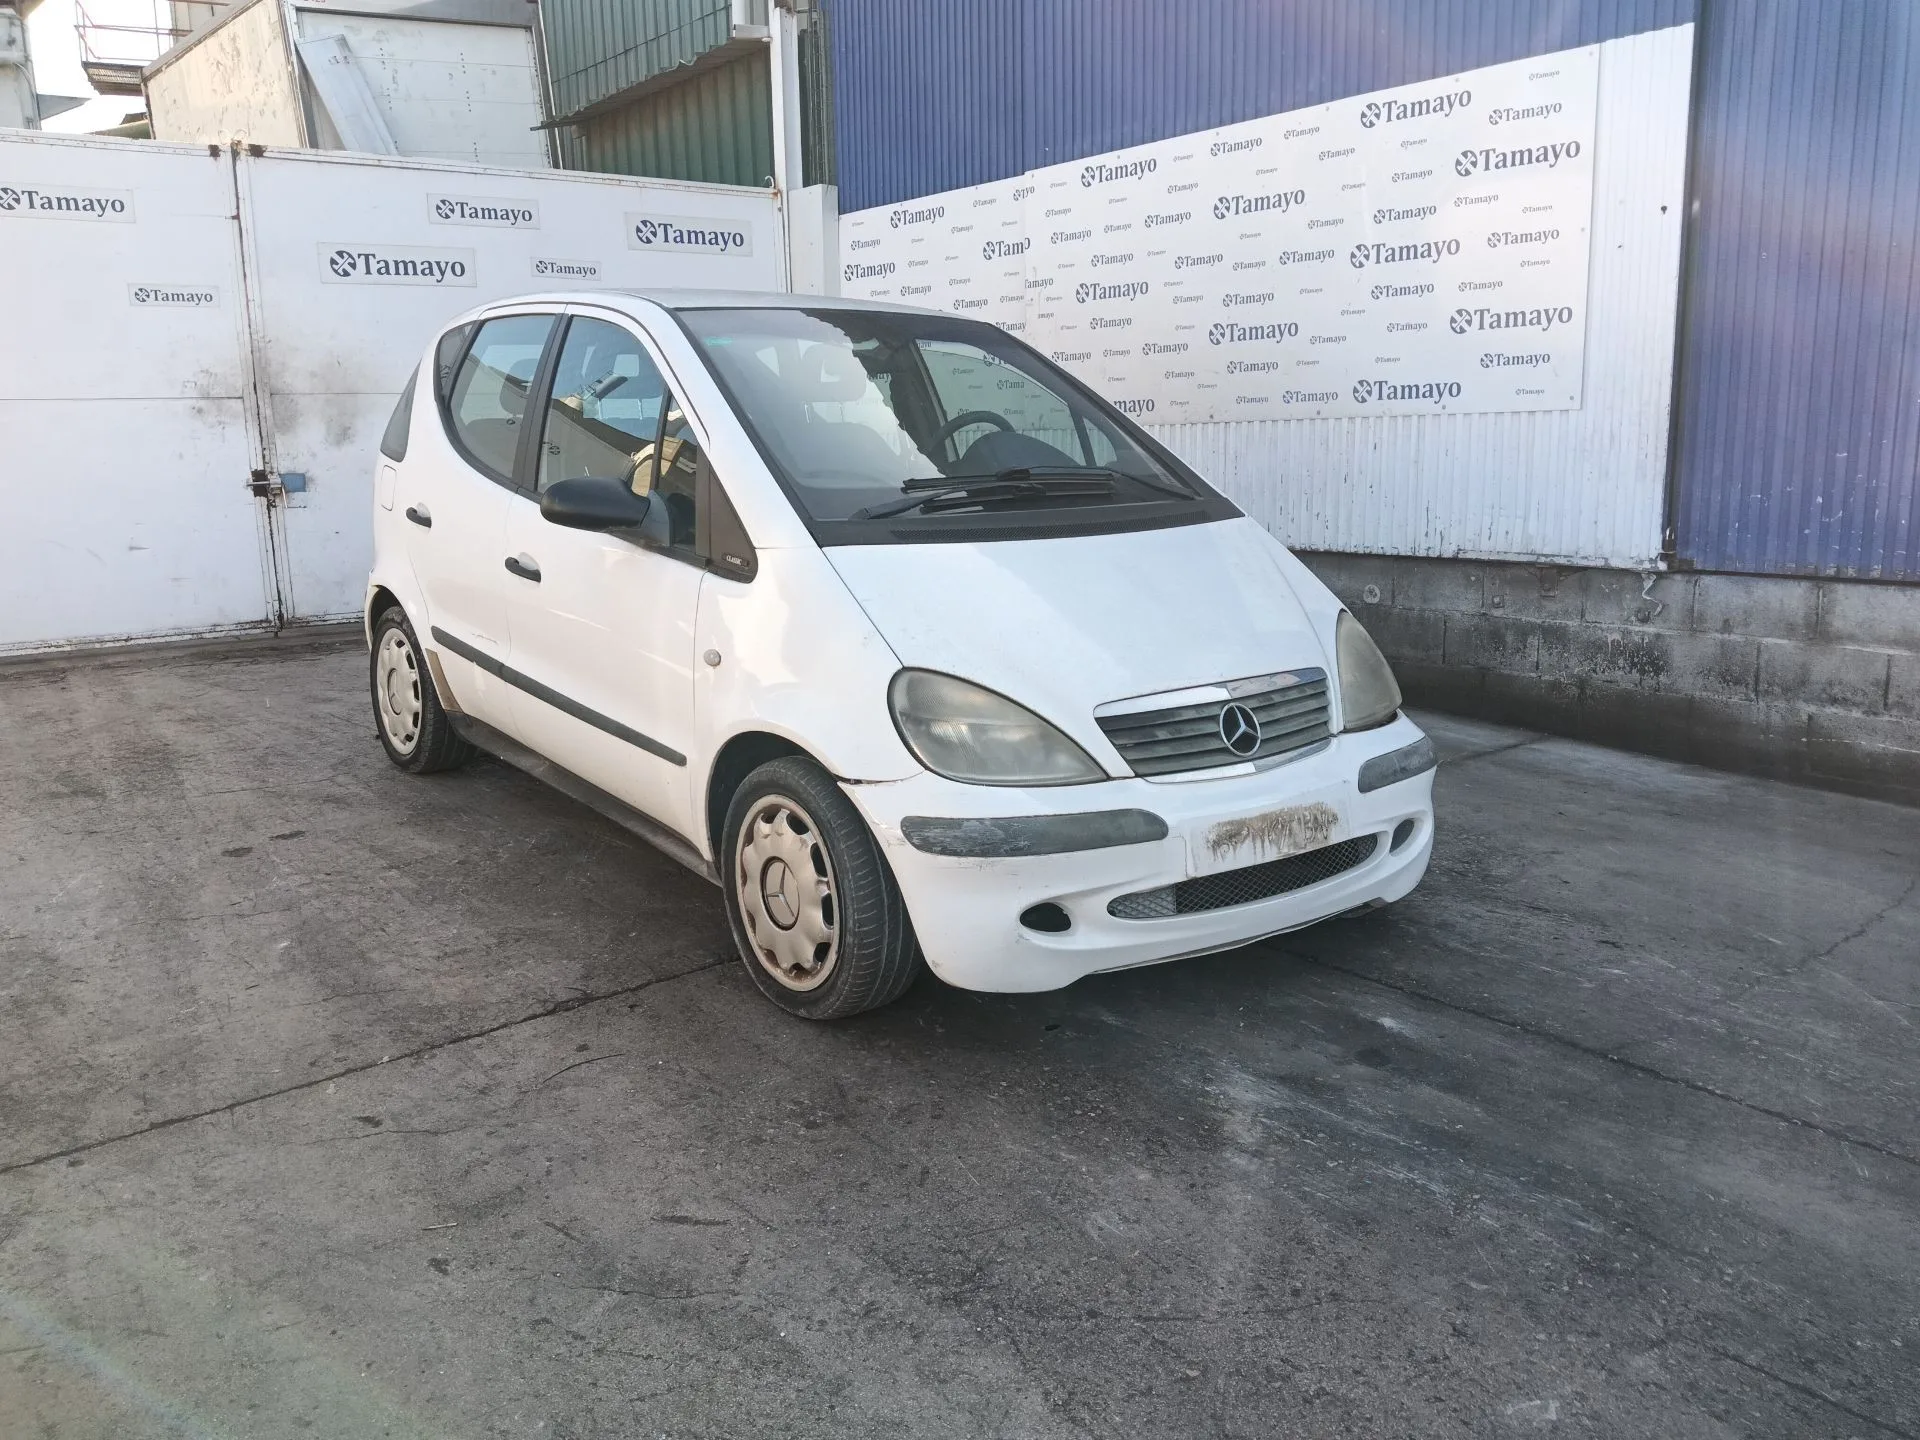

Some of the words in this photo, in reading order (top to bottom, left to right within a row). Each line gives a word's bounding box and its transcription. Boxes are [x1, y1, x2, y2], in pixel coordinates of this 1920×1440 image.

[1534, 70, 1560, 80] Tamayo
[1382, 90, 1472, 122] Tamayo
[1503, 103, 1562, 121] Tamayo
[1290, 127, 1319, 138] Tamayo
[1221, 138, 1262, 154] Tamayo
[1326, 148, 1355, 159] Tamayo
[1479, 141, 1580, 171] Tamayo
[1096, 157, 1157, 184] Tamayo
[1398, 170, 1432, 180] Tamayo
[1172, 183, 1198, 192] Tamayo
[21, 190, 124, 217] Tamayo
[1232, 190, 1305, 215] Tamayo
[1463, 195, 1498, 205] Tamayo
[456, 202, 532, 225] Tamayo
[901, 206, 944, 225] Tamayo
[1154, 212, 1191, 225] Tamayo
[1386, 206, 1436, 221] Tamayo
[1315, 218, 1344, 228] Tamayo
[658, 223, 744, 252] Tamayo
[1058, 230, 1091, 242] Tamayo
[1502, 230, 1559, 245] Tamayo
[856, 239, 880, 249] Tamayo
[1289, 249, 1334, 263] Tamayo
[1372, 239, 1460, 264] Tamayo
[1098, 253, 1133, 265] Tamayo
[1182, 254, 1223, 267] Tamayo
[1238, 261, 1266, 270] Tamayo
[357, 253, 465, 283] Tamayo
[548, 262, 596, 277] Tamayo
[854, 262, 896, 279] Tamayo
[907, 285, 931, 295] Tamayo
[1090, 282, 1148, 301] Tamayo
[1383, 284, 1434, 297] Tamayo
[1466, 281, 1503, 290] Tamayo
[150, 290, 213, 305] Tamayo
[960, 299, 988, 309] Tamayo
[1179, 295, 1203, 303] Tamayo
[1233, 293, 1274, 305] Tamayo
[1097, 318, 1132, 329] Tamayo
[1474, 307, 1572, 332] Tamayo
[1226, 323, 1298, 343] Tamayo
[1395, 322, 1427, 331] Tamayo
[1318, 336, 1346, 344] Tamayo
[1150, 343, 1188, 354] Tamayo
[1059, 352, 1091, 363] Tamayo
[1494, 353, 1550, 368] Tamayo
[1237, 361, 1278, 374] Tamayo
[1170, 371, 1195, 379] Tamayo
[1294, 391, 1338, 404] Tamayo
[1374, 381, 1461, 404] Tamayo
[1242, 396, 1268, 404] Tamayo
